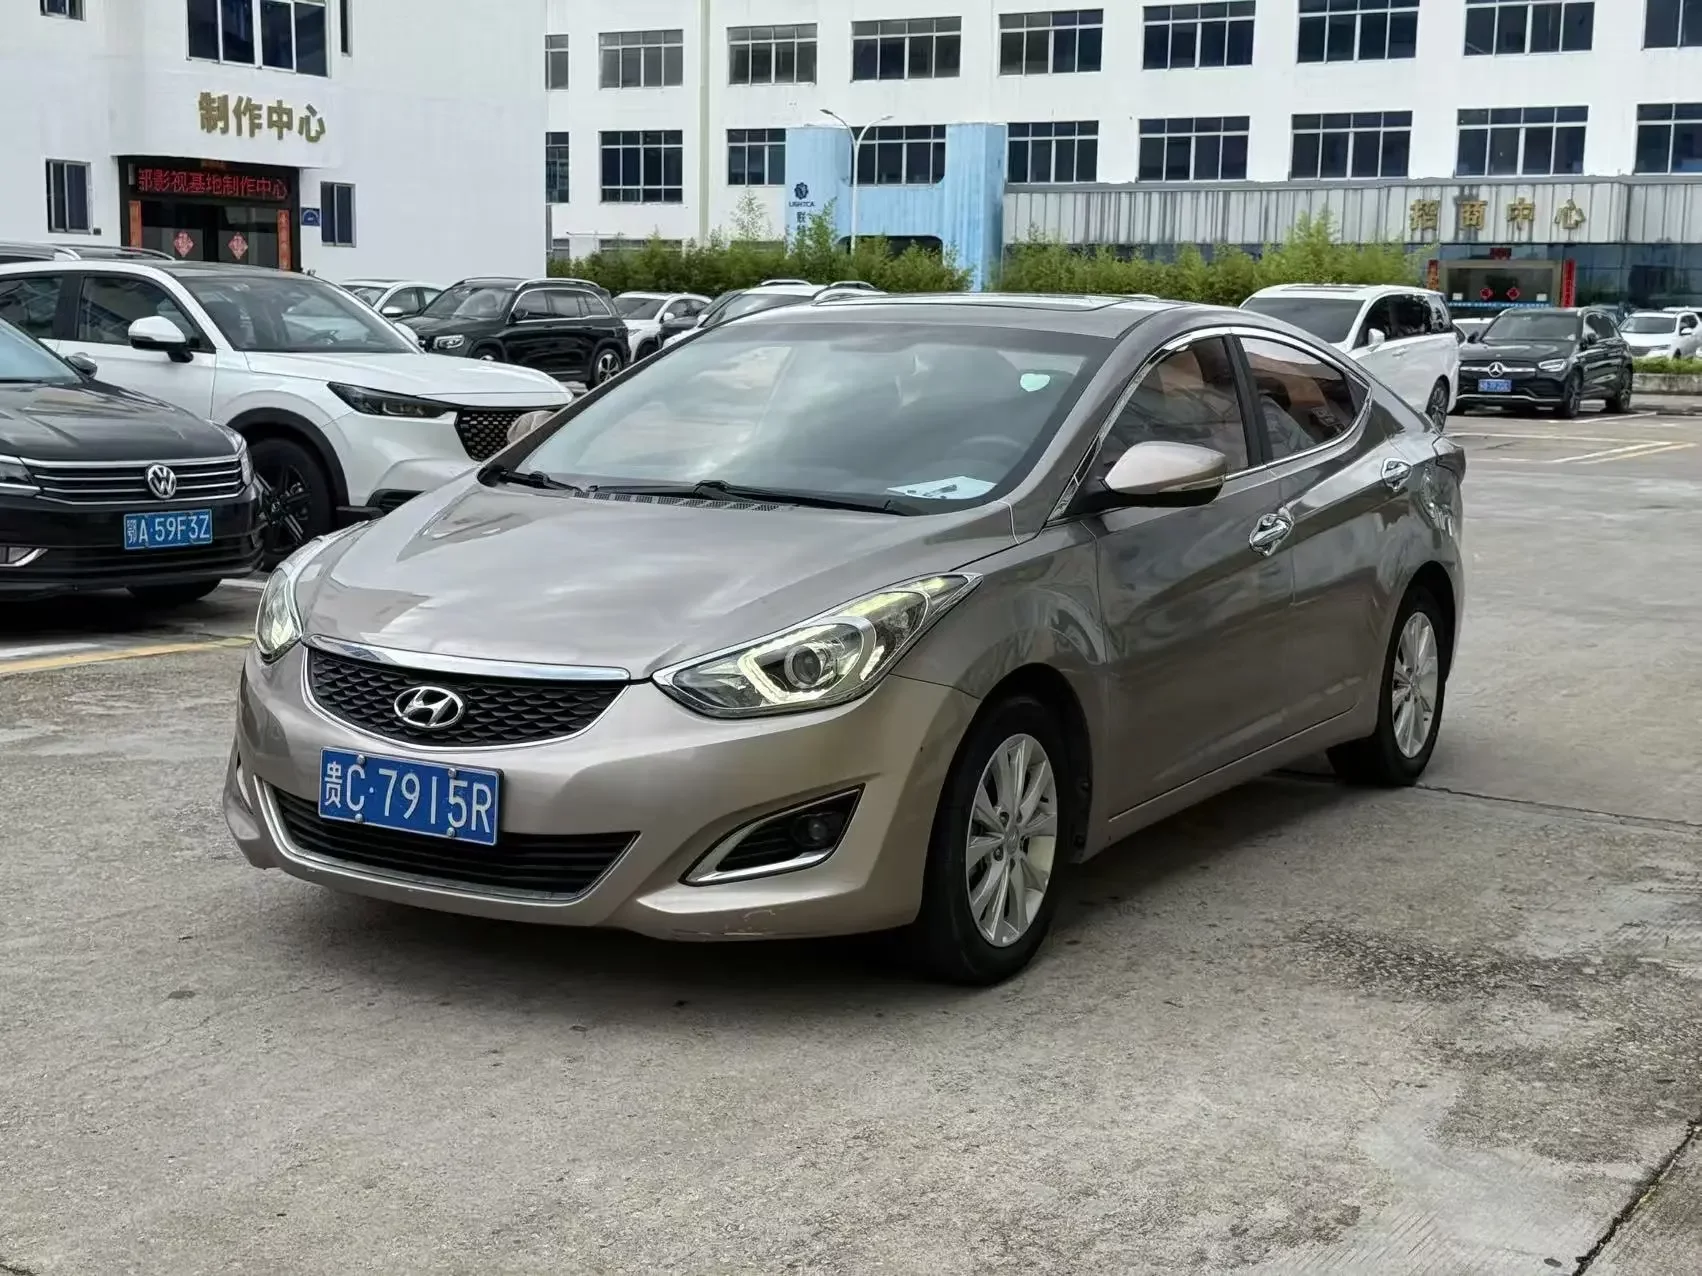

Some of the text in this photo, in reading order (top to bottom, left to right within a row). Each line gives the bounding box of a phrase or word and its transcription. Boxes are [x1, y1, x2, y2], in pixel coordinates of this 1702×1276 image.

[199, 91, 326, 143] 制作中心
[1409, 197, 1586, 231] 招商中心
